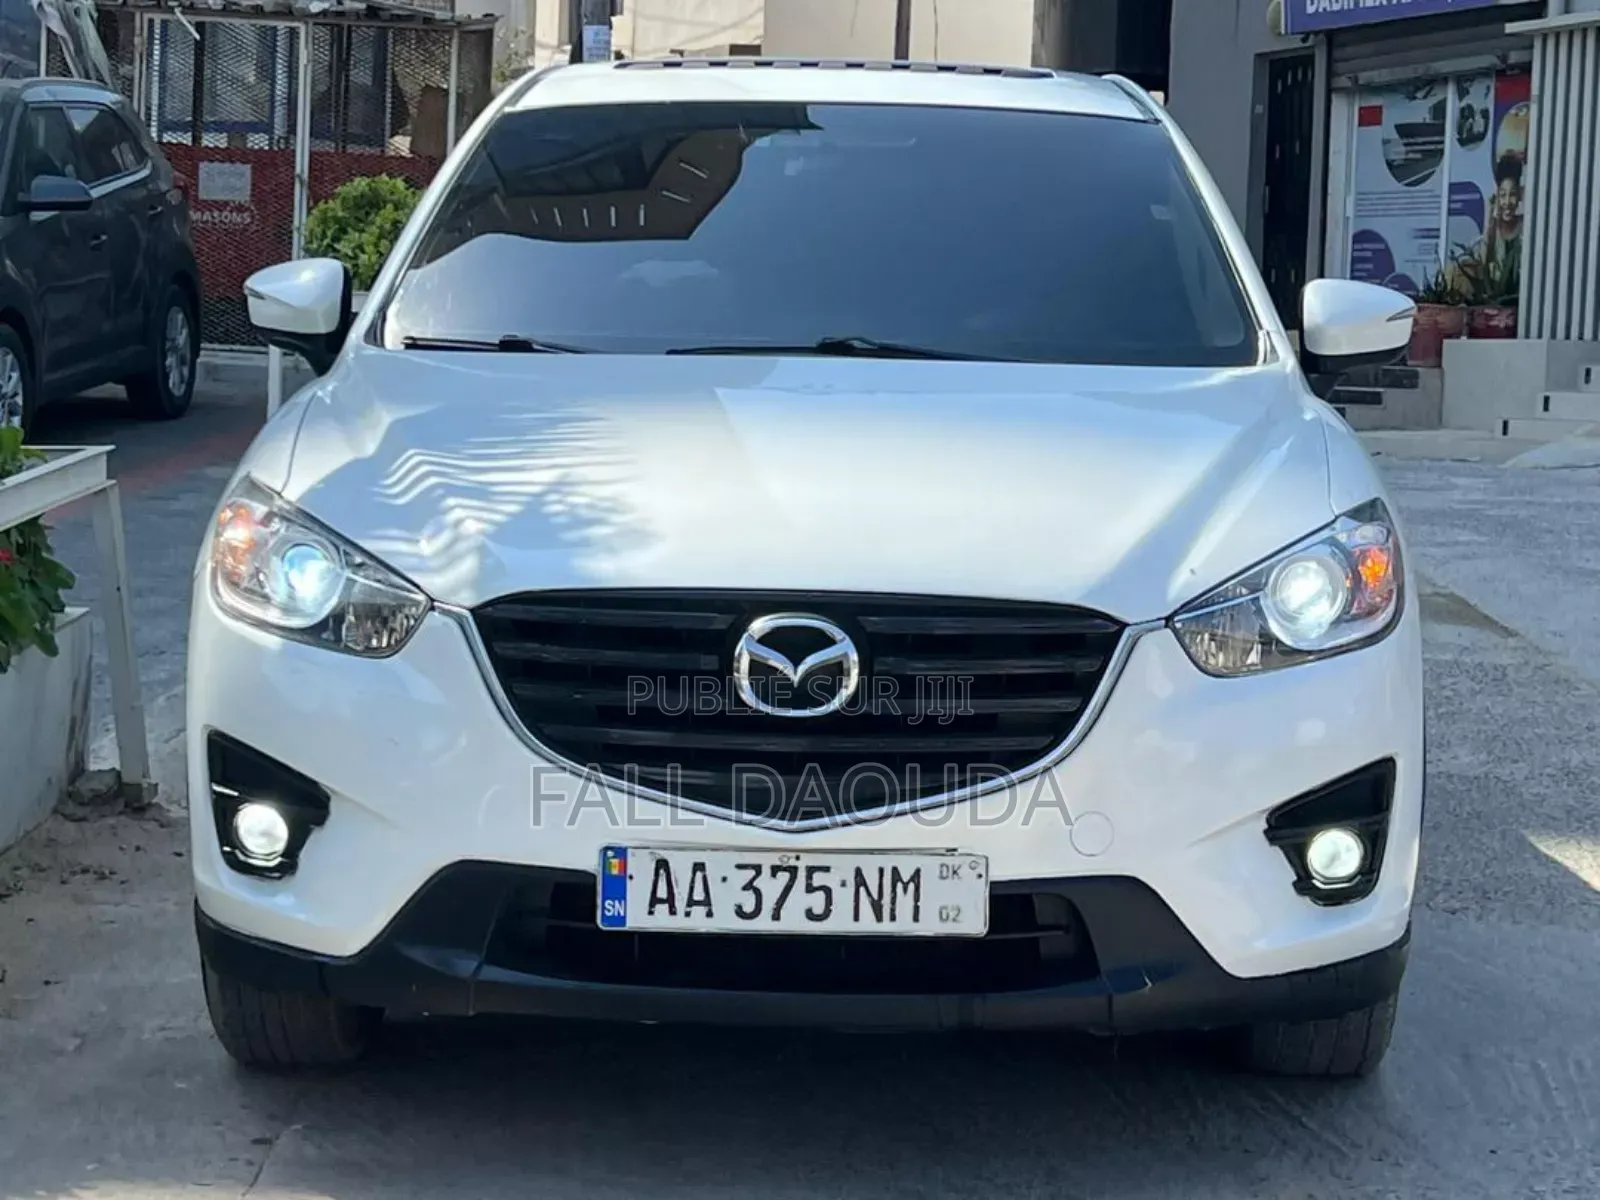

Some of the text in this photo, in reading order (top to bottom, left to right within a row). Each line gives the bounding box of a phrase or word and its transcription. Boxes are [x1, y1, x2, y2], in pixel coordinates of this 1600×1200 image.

[938, 863, 963, 881] DK
[604, 900, 625, 917] SN
[938, 906, 963, 923] 02
